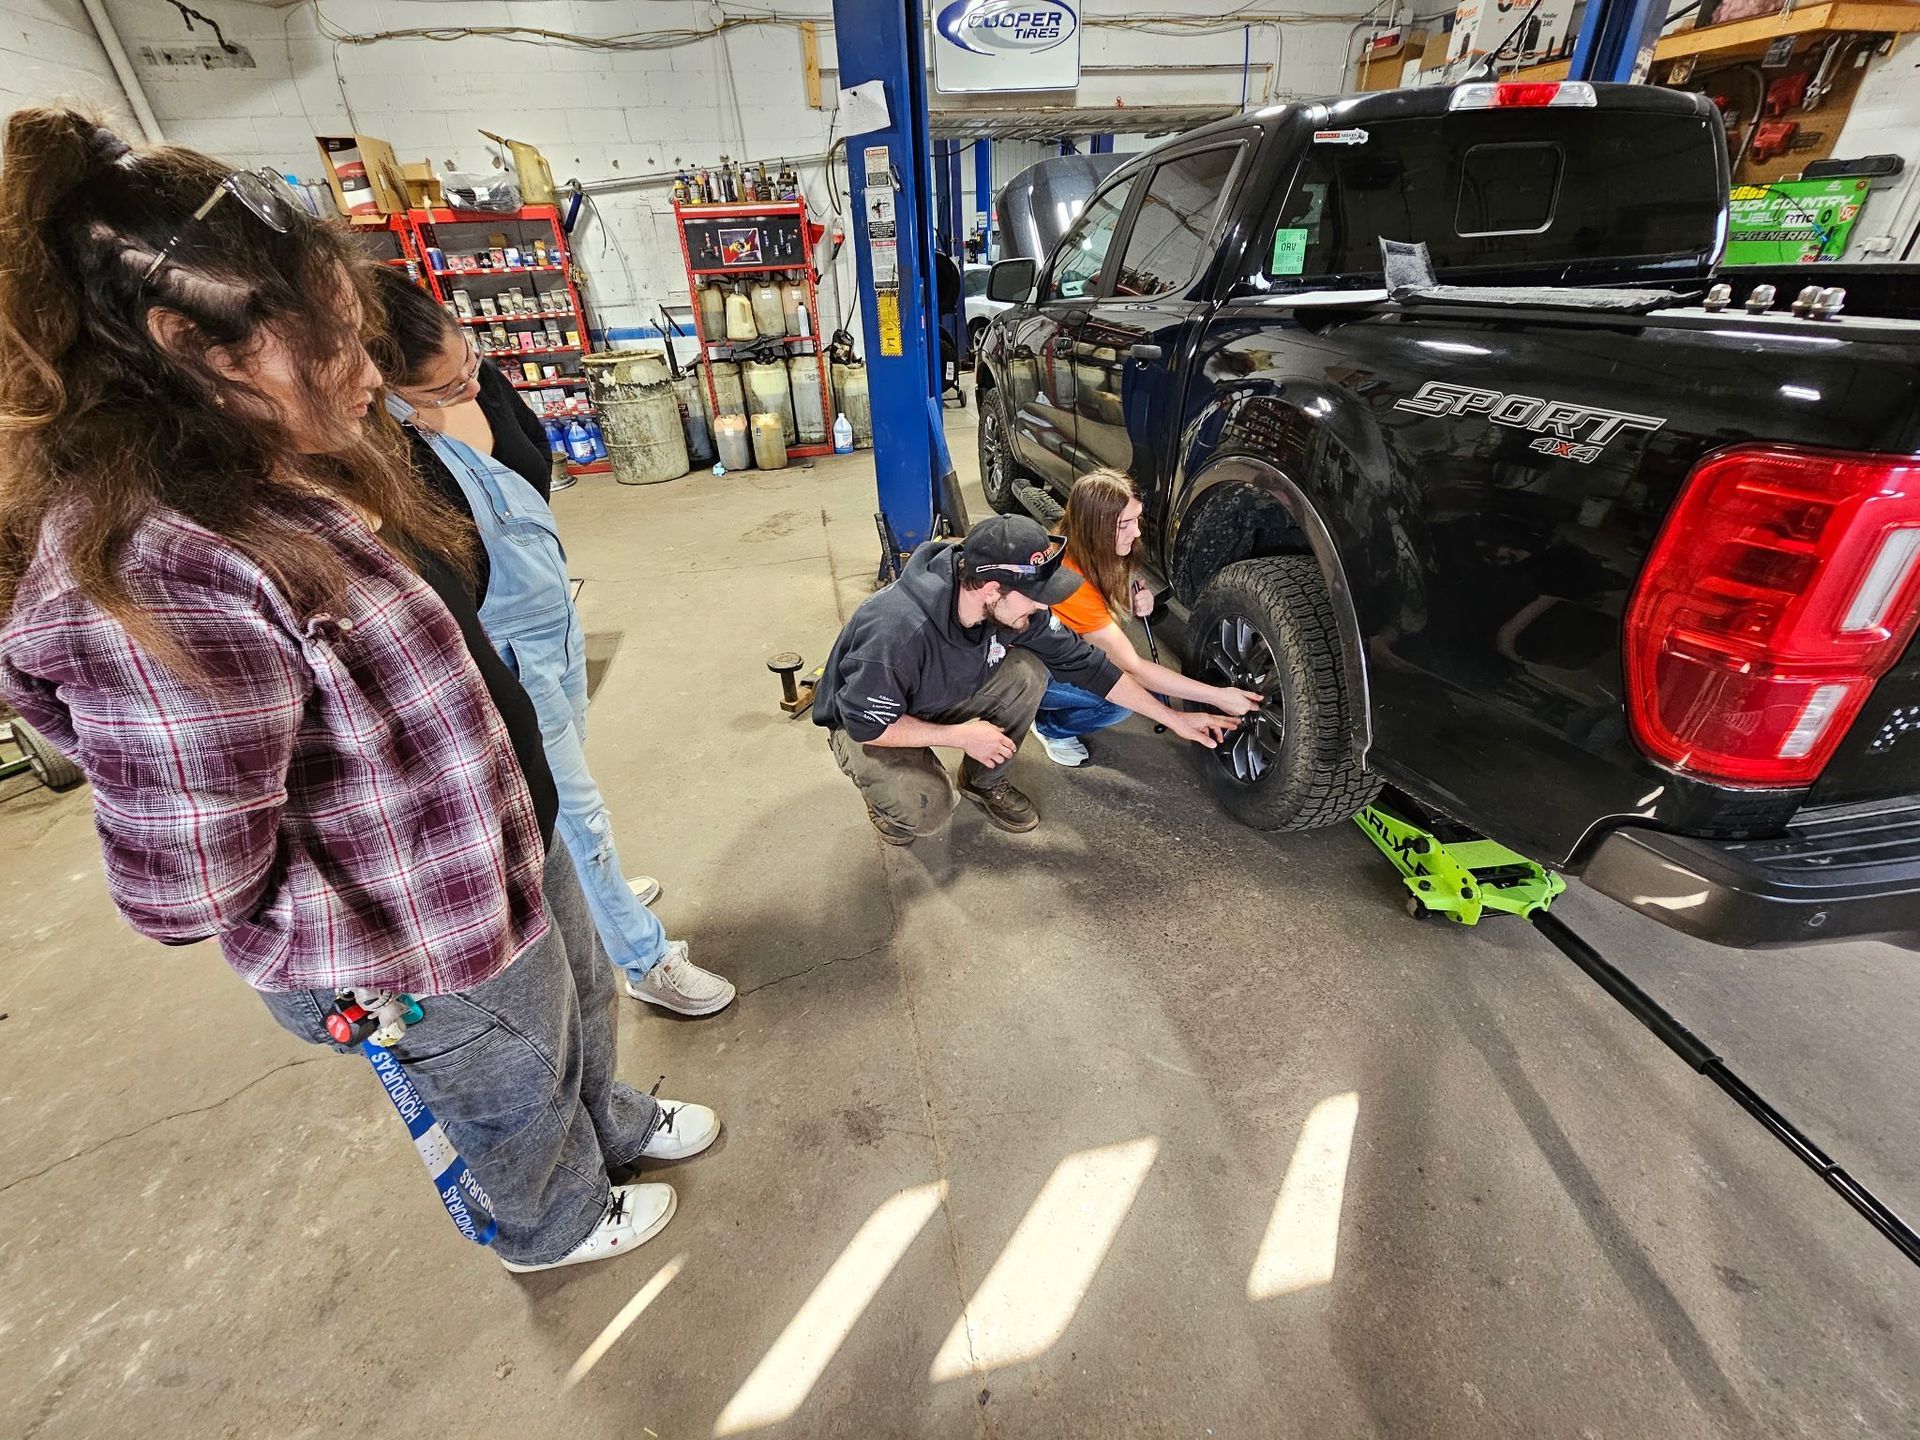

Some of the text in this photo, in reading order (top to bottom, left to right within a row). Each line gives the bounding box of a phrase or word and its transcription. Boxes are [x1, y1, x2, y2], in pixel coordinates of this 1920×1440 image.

[968, 12, 1062, 28] COOPER
[1014, 28, 1059, 39] TIRES
[1771, 195, 1855, 210] COUNTRY
[1783, 214, 1815, 224] RTIC
[1746, 231, 1817, 241] GENERAL
[1280, 242, 1297, 252] ORV
[1393, 380, 1667, 446] SPORT
[371, 1051, 421, 1124] HONDURAS
